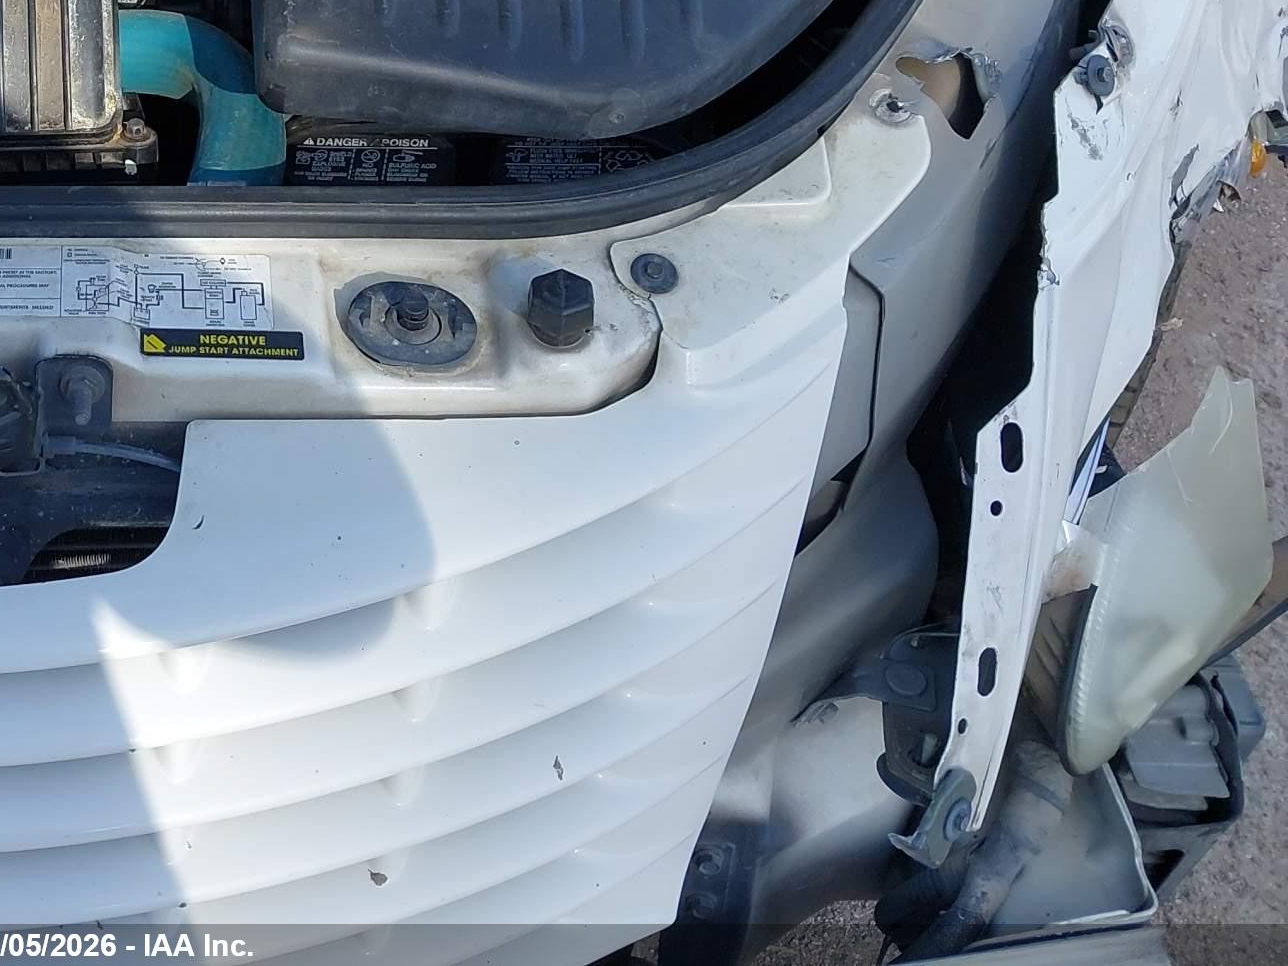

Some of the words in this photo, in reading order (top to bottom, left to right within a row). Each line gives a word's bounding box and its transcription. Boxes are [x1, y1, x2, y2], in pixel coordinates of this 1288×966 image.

[316, 137, 368, 147] DANGER
[381, 138, 430, 147] POISON
[200, 334, 266, 346] NEGATIVE
[168, 345, 197, 354] JUMP
[199, 346, 228, 355] START
[231, 347, 299, 357] ATTACHMENT
